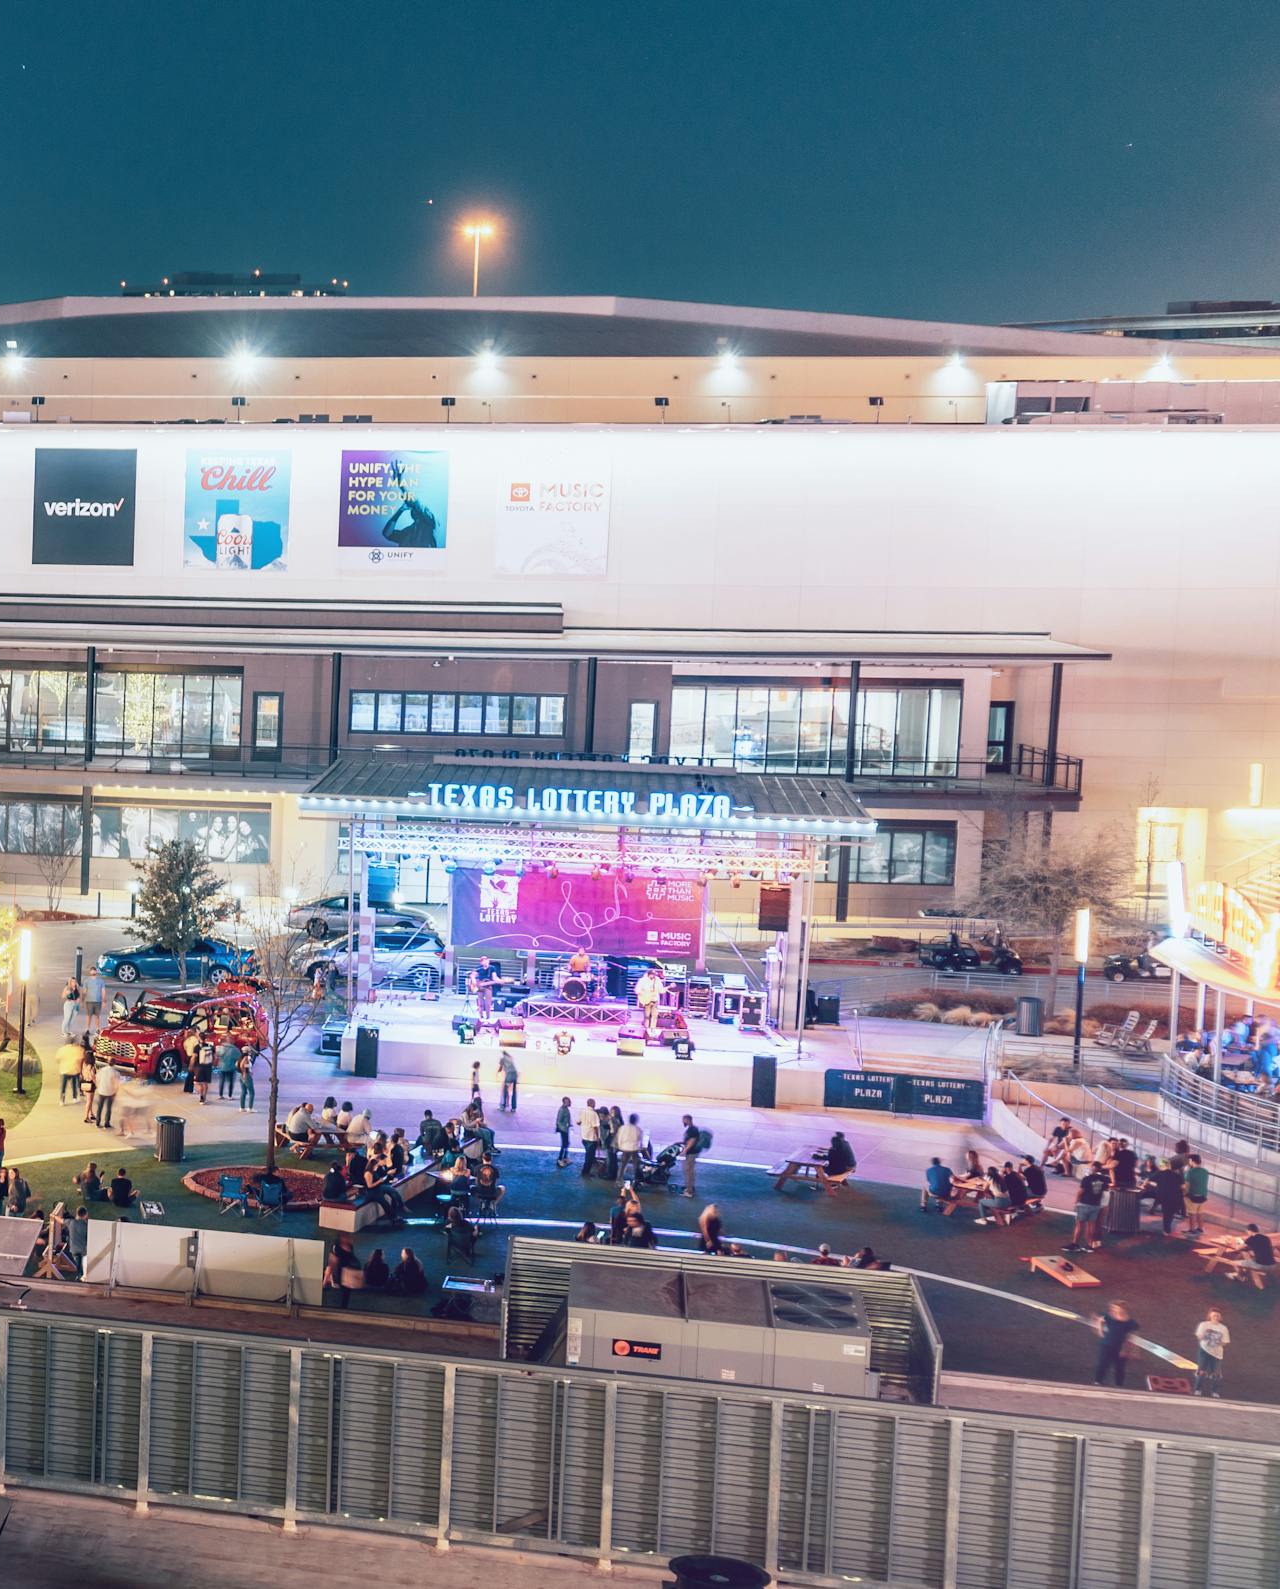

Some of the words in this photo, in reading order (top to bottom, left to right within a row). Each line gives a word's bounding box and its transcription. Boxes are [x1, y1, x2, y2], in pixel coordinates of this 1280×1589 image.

[349, 462, 394, 475] UNIFY,
[200, 465, 277, 491] Chill
[348, 476, 384, 488] HYPE
[387, 477, 419, 488] MAN
[347, 490, 376, 501] FOR
[379, 490, 416, 501] YOUR
[540, 483, 605, 498] MUSIC
[43, 498, 116, 517] verizon
[347, 504, 397, 516] MONEY
[539, 501, 602, 512] FACTORY
[387, 551, 415, 559] UNIFY
[428, 783, 514, 810] TEXAS
[527, 786, 635, 815] LOTTERY
[650, 792, 731, 819] PLAZA
[480, 912, 517, 924] LOTTERY
[660, 931, 692, 940] MUSIC
[843, 1073, 865, 1081] TEXAS
[868, 1075, 895, 1083] LOTTERY
[912, 1079, 935, 1087] TEXAS
[938, 1081, 966, 1090] LOTTERY
[854, 1087, 883, 1098] PLAZA
[924, 1094, 953, 1105] PLAZA
[633, 1345, 659, 1355] TRANE
